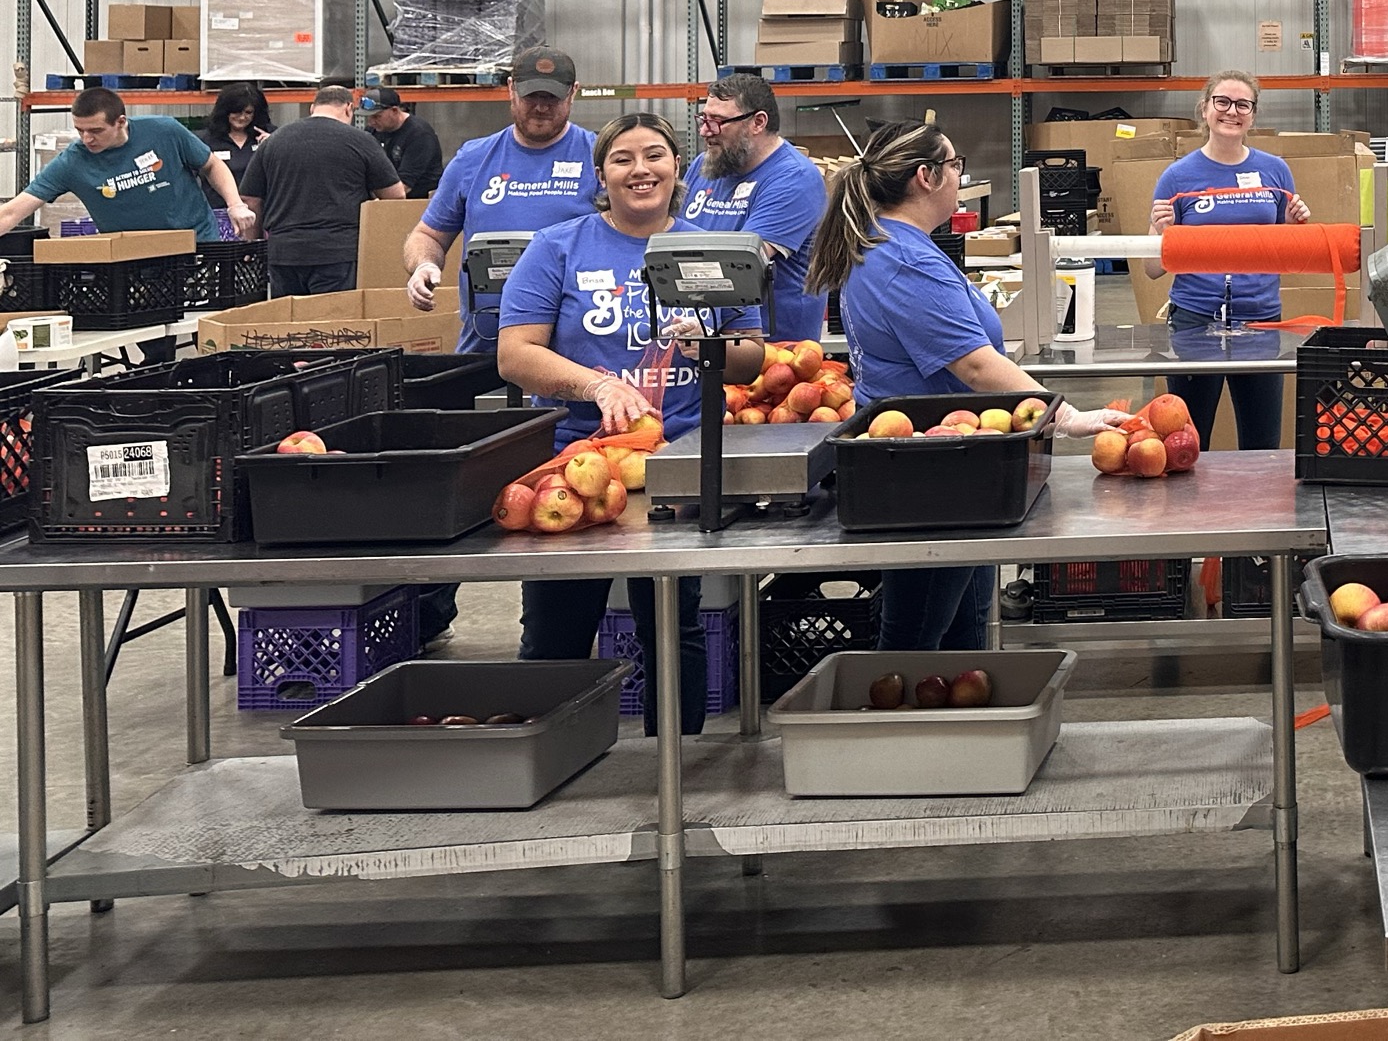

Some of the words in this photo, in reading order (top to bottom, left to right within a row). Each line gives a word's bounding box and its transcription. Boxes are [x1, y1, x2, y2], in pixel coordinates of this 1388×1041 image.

[116, 171, 157, 191] HUNGER
[509, 181, 551, 190] General
[554, 180, 580, 190] Mills
[1256, 190, 1274, 198] Mills
[706, 198, 733, 208] General
